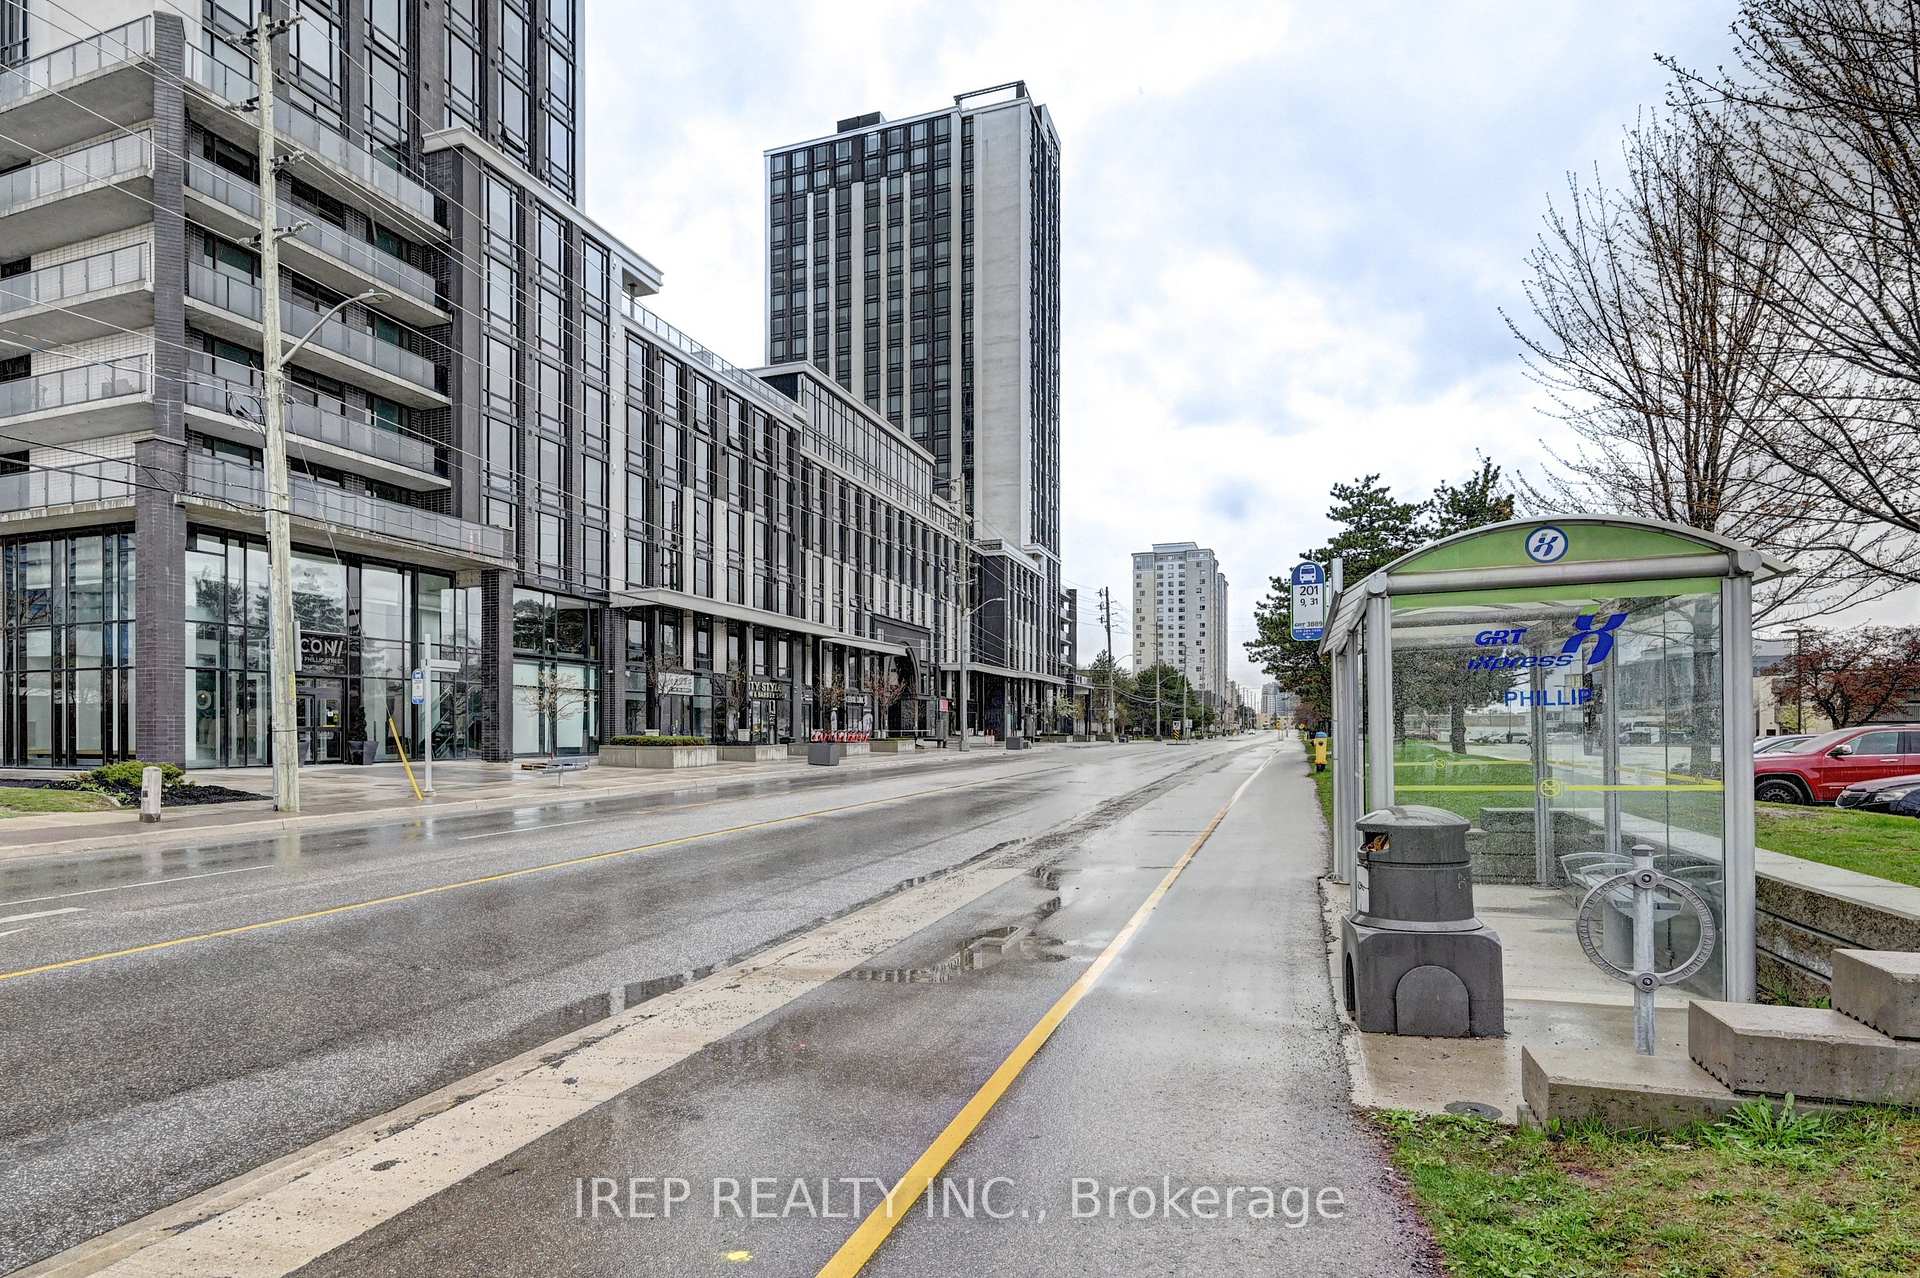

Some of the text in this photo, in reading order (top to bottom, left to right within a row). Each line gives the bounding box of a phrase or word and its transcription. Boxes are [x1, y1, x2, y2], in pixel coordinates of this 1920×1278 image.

[1300, 586, 1318, 596] 201
[1300, 598, 1318, 608] 9, 31
[1474, 628, 1527, 647] GRT
[1504, 688, 1594, 708] PHILLIP
